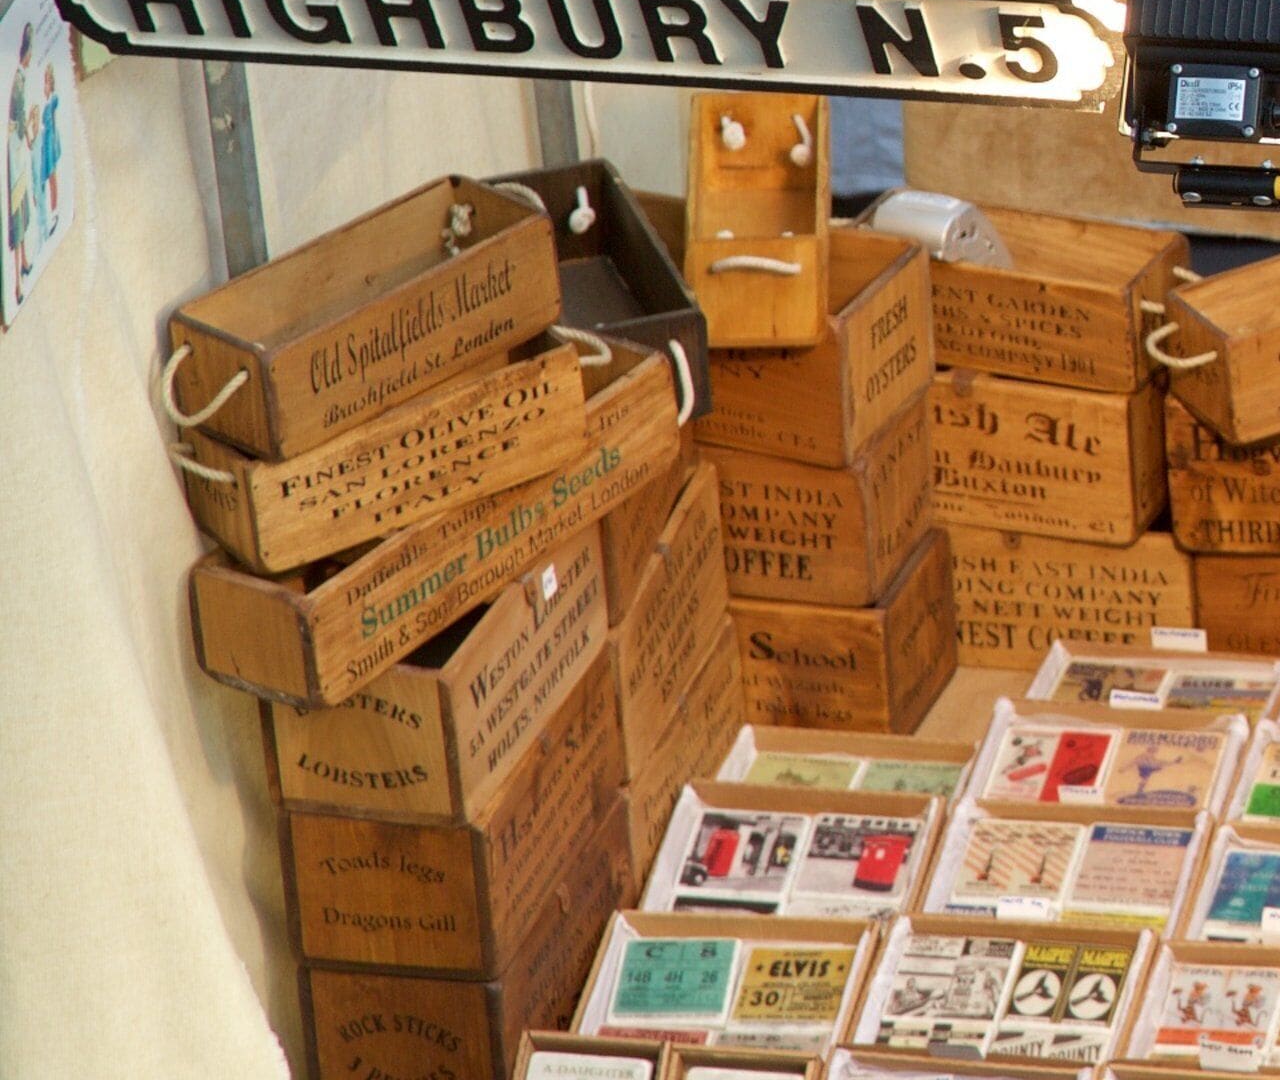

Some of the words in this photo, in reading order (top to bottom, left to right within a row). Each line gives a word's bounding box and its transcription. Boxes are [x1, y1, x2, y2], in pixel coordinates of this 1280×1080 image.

[855, 3, 1059, 84] N.5
[869, 302, 909, 350] FRESH
[986, 290, 1090, 321] GARDEN
[309, 350, 342, 394] Old
[343, 300, 445, 383] Spitalfields
[452, 263, 514, 317] Market
[323, 378, 420, 427] Brushfield
[452, 317, 515, 359] London
[865, 338, 917, 402] OYSTERS
[1025, 412, 1102, 455] Ale
[299, 479, 365, 513] SAN
[383, 407, 546, 472] LORENZO
[331, 438, 521, 520] FLORENCE
[373, 473, 486, 523] ITALY
[763, 485, 844, 507] INDIA
[360, 553, 466, 638] Summer
[475, 499, 545, 562] Bulbs
[551, 445, 622, 503] Seeds
[728, 526, 835, 549] WEIGHT
[346, 644, 394, 684] Smith
[458, 547, 522, 604] Borough
[591, 462, 650, 511] London
[1008, 560, 1098, 580] EAST
[1108, 565, 1168, 586] INDIA
[1026, 583, 1162, 607] COMPANY
[974, 601, 1045, 619] NETT
[1055, 604, 1159, 625] WEIGHT
[297, 753, 429, 789] LOBSTERS
[769, 960, 830, 978] ELVIS
[750, 990, 779, 1007] 30
